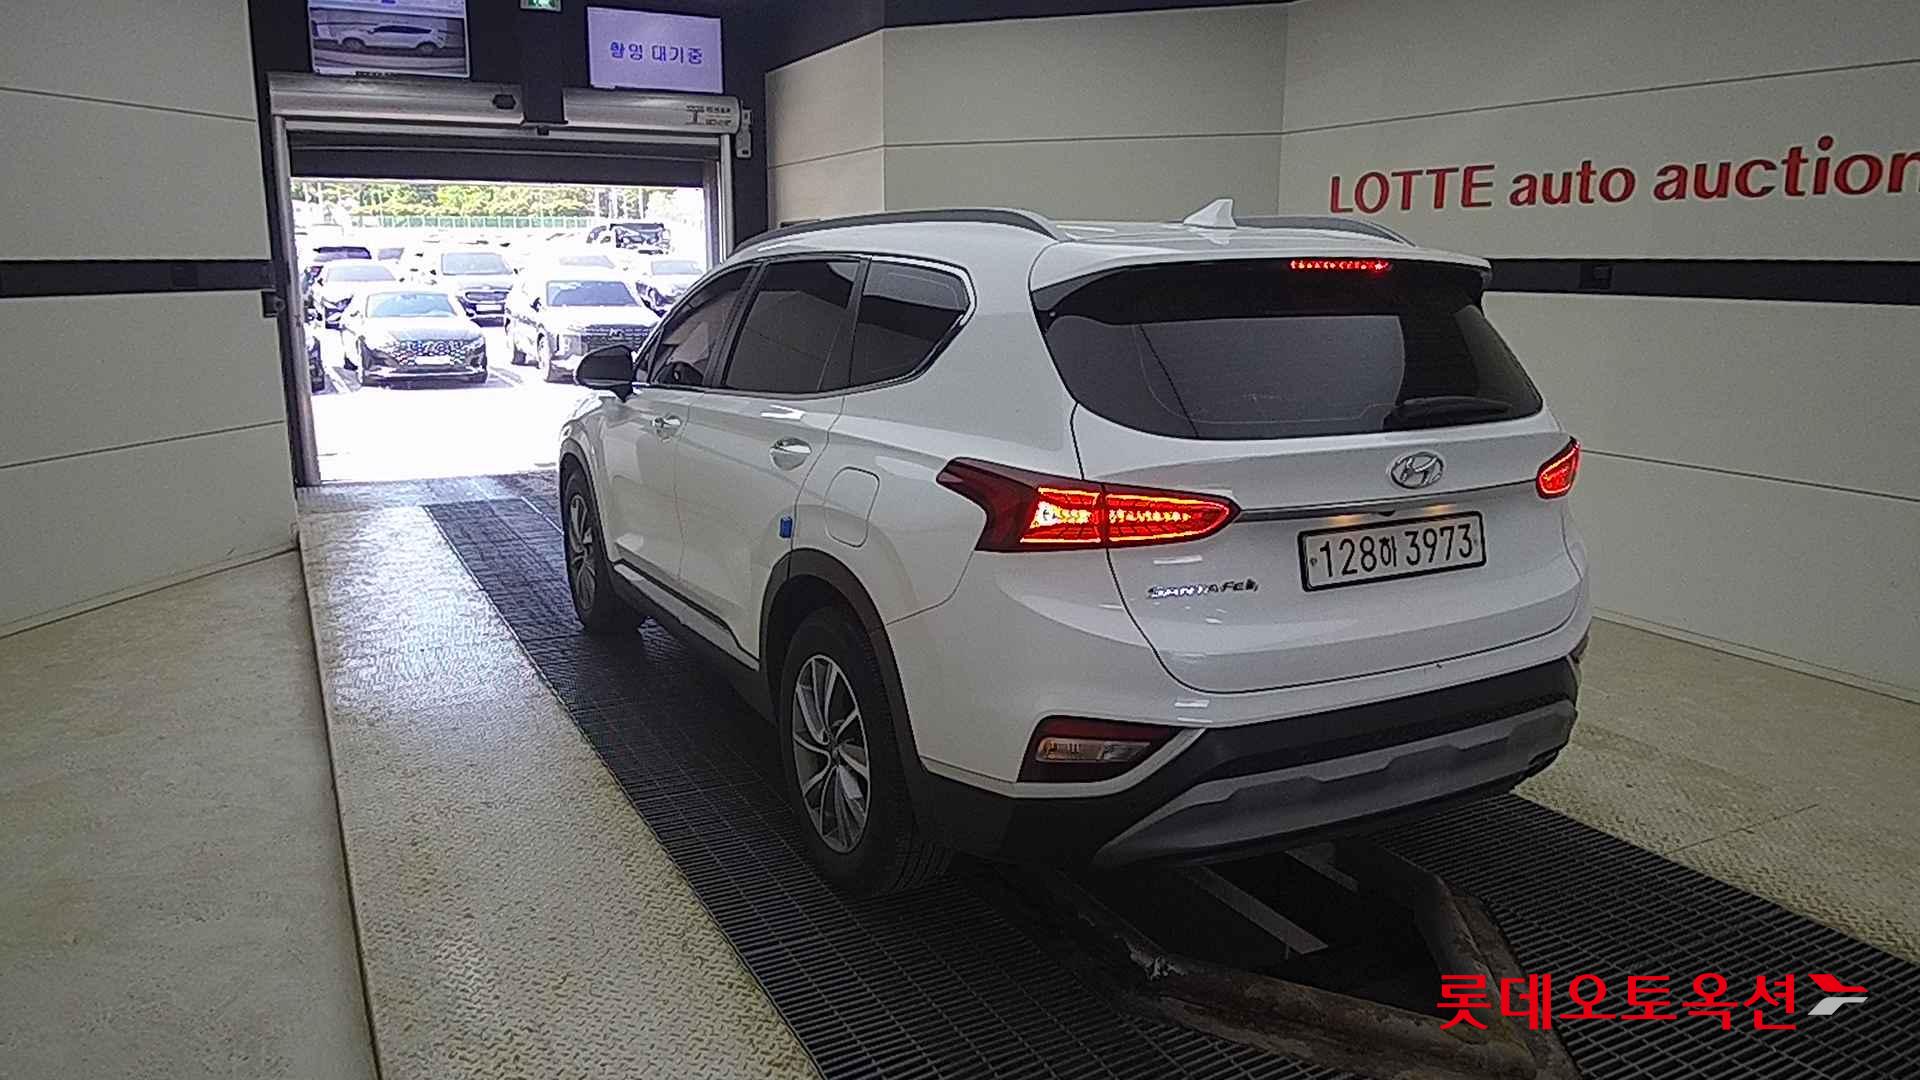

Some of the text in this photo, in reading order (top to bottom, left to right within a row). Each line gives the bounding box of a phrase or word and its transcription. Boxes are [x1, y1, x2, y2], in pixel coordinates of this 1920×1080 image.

[651, 44, 703, 65] 대기중
[1329, 135, 1920, 213] LOTTE auto auction
[1404, 523, 1473, 567] 3973
